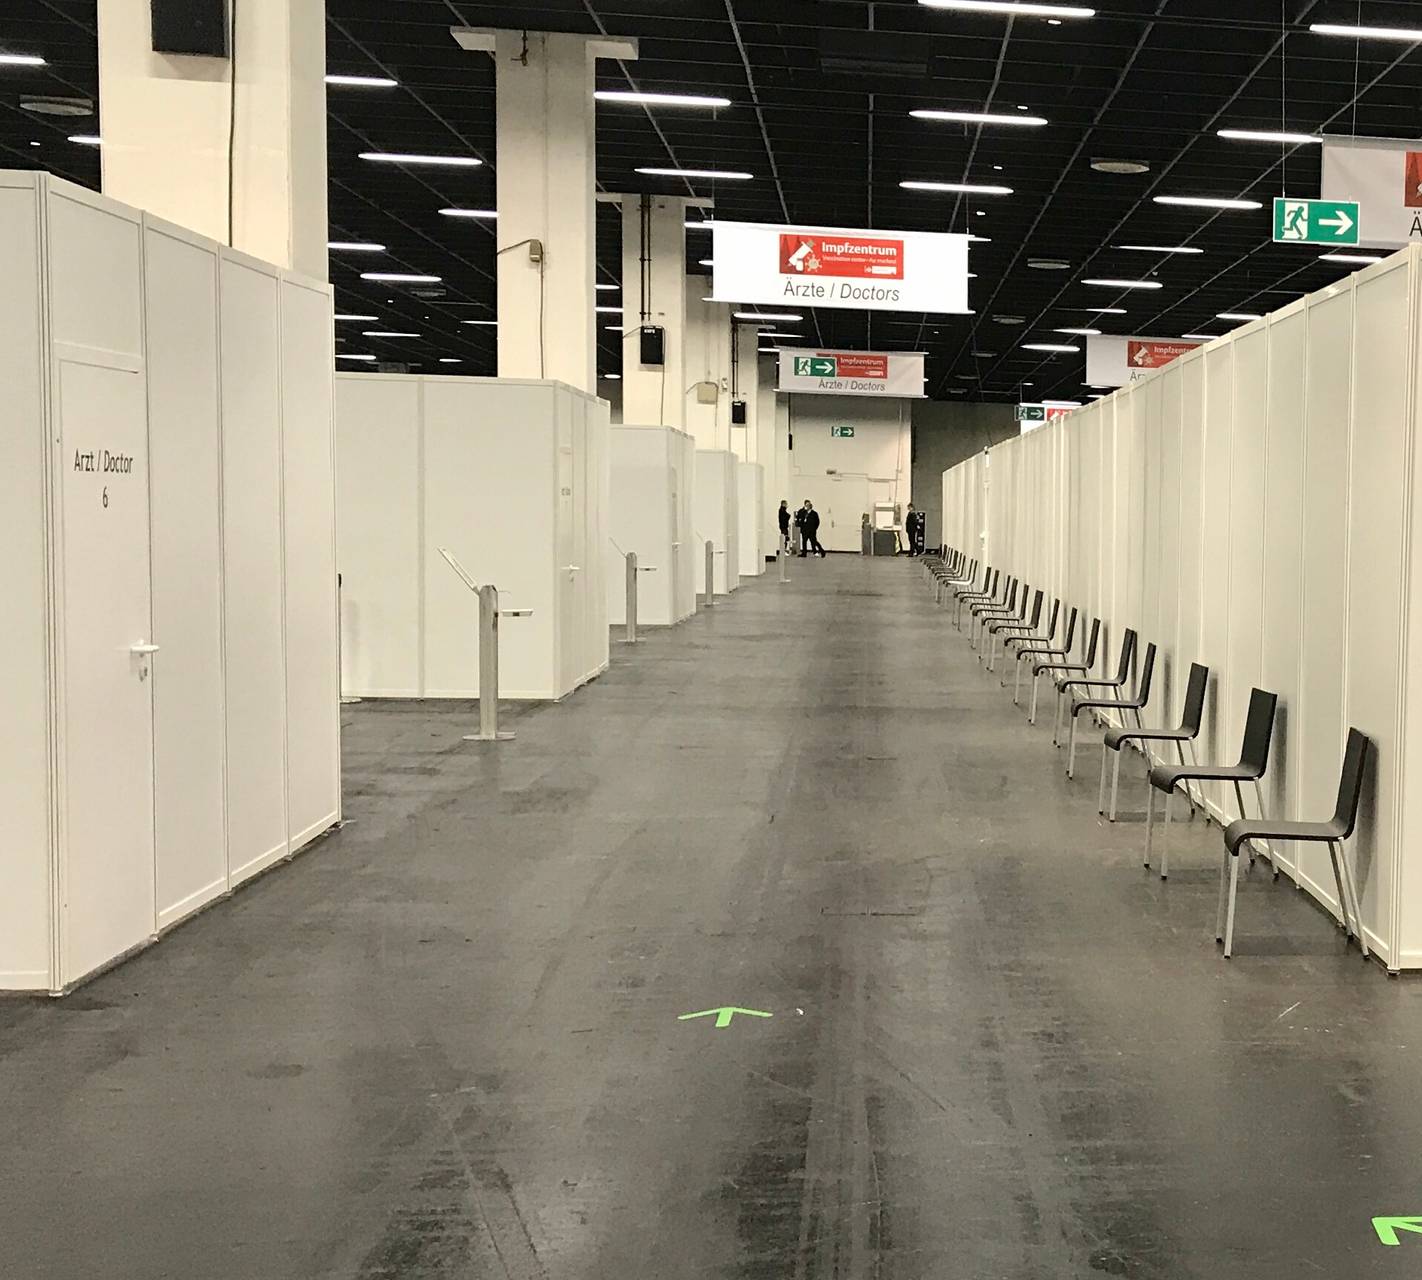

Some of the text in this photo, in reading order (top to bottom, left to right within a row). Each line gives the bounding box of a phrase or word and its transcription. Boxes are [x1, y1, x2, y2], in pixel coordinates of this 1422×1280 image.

[822, 242, 897, 256] Impfzentrum
[783, 277, 825, 298] Ärzte
[840, 283, 900, 301] Doctors
[851, 380, 886, 391] Doctors
[74, 448, 95, 472] Arzt
[104, 450, 133, 473] Doctor
[102, 486, 109, 509] 6
